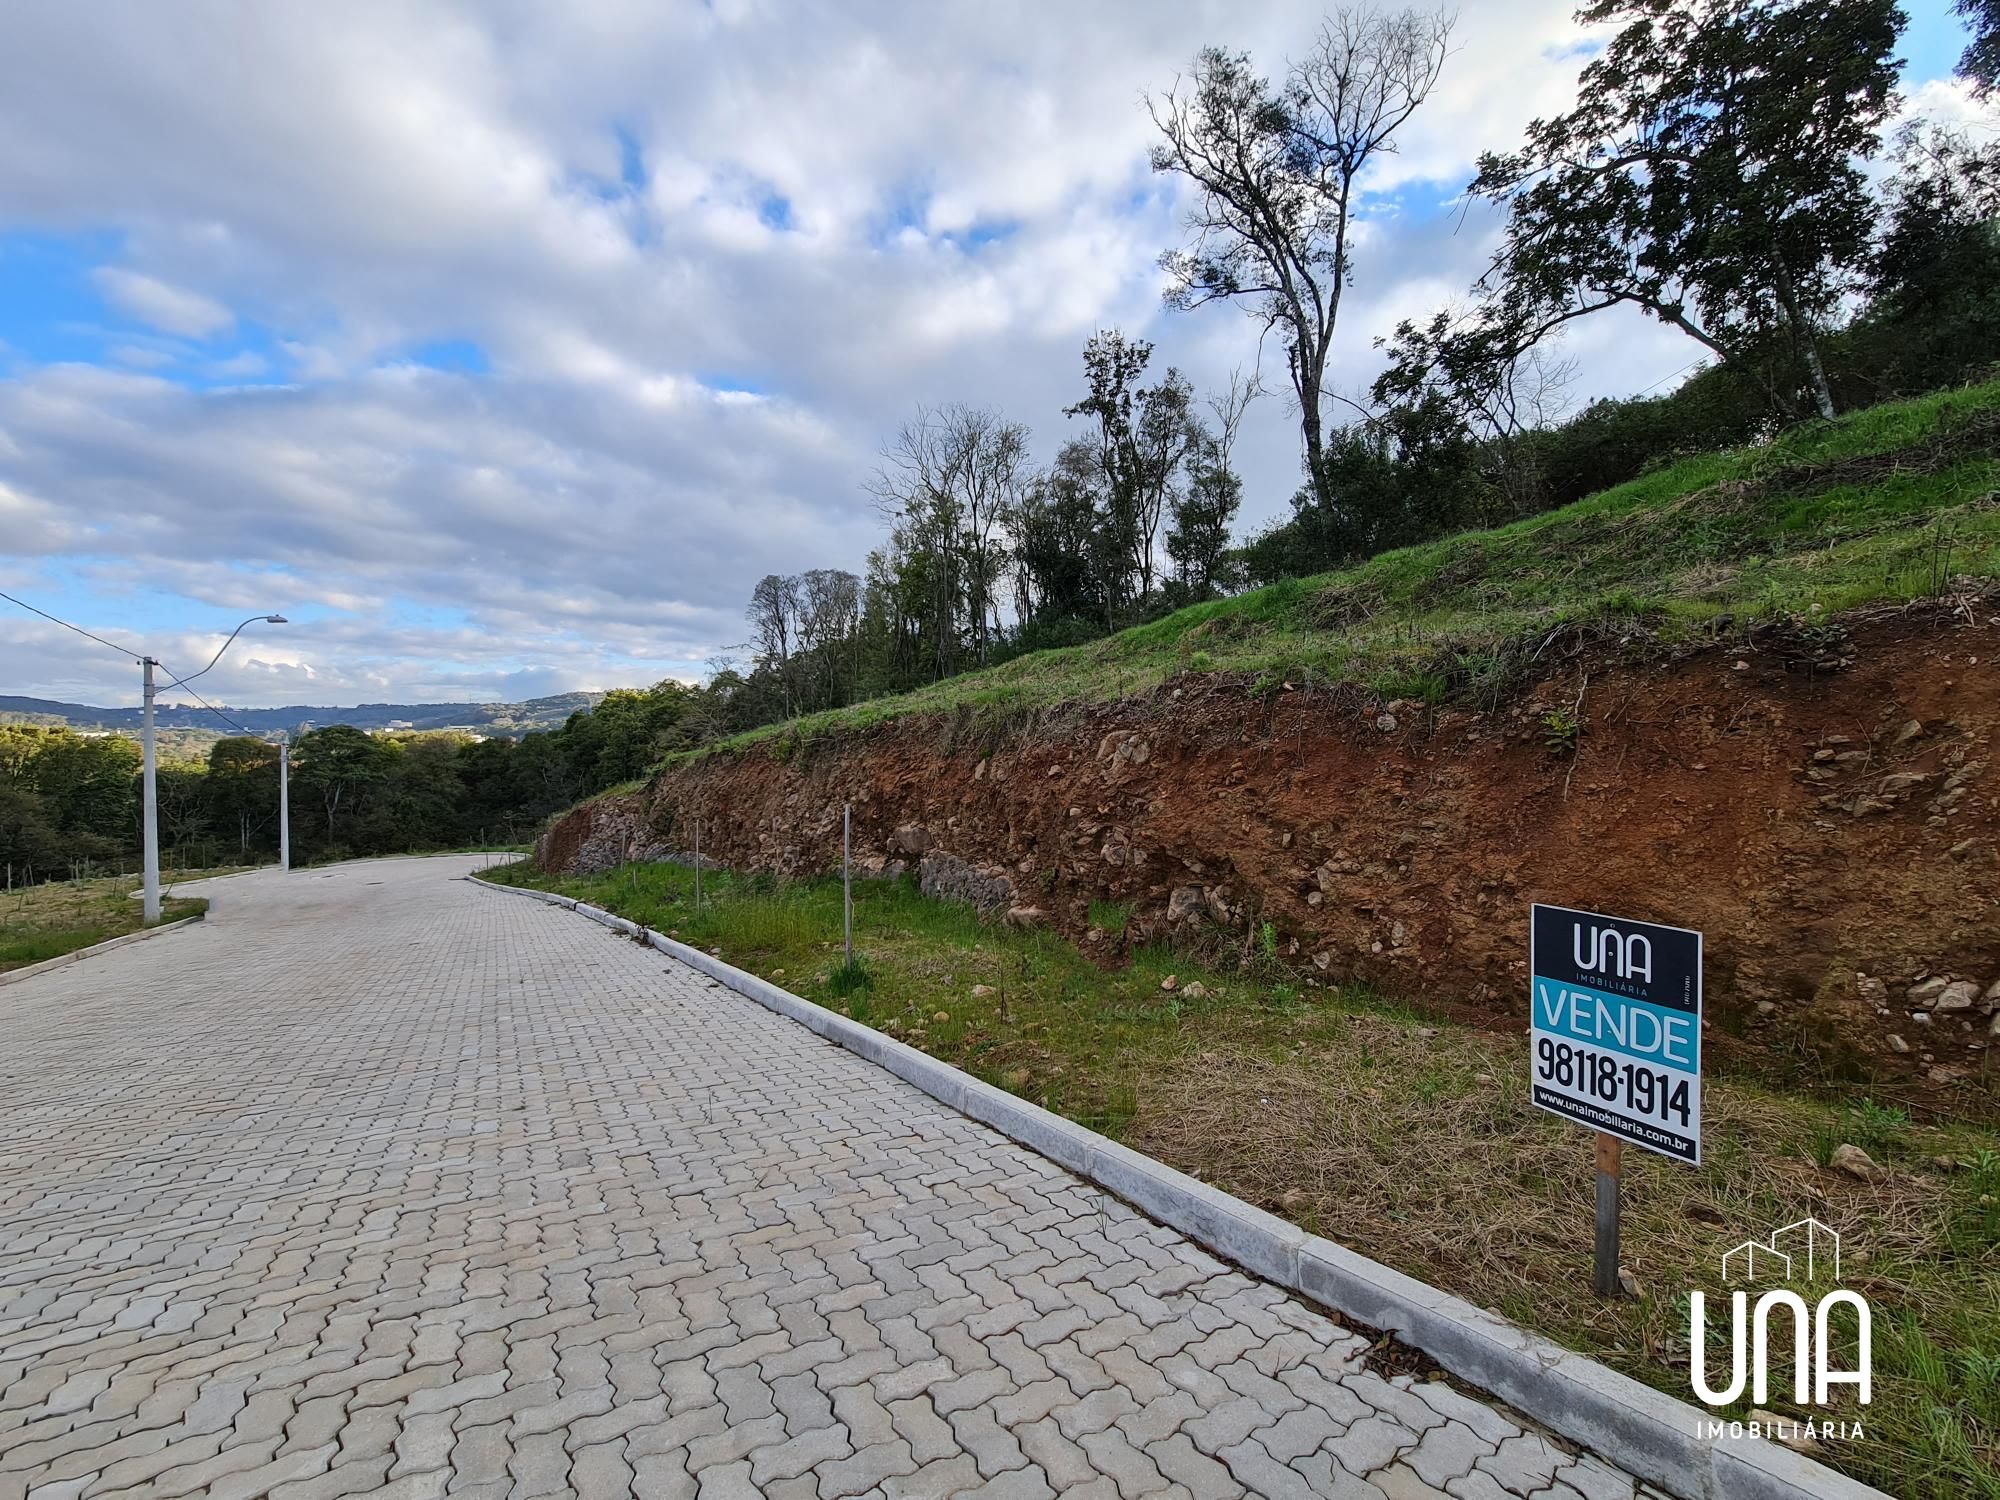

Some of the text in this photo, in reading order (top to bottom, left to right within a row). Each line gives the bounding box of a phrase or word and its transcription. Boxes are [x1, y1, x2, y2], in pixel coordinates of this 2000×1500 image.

[1573, 922, 1652, 984] UNA
[1576, 972, 1648, 997] IMOBILIÁRIA
[1539, 983, 1690, 1065] VENDE
[1539, 1090, 1689, 1152] www.unaimobiliaria.com.br
